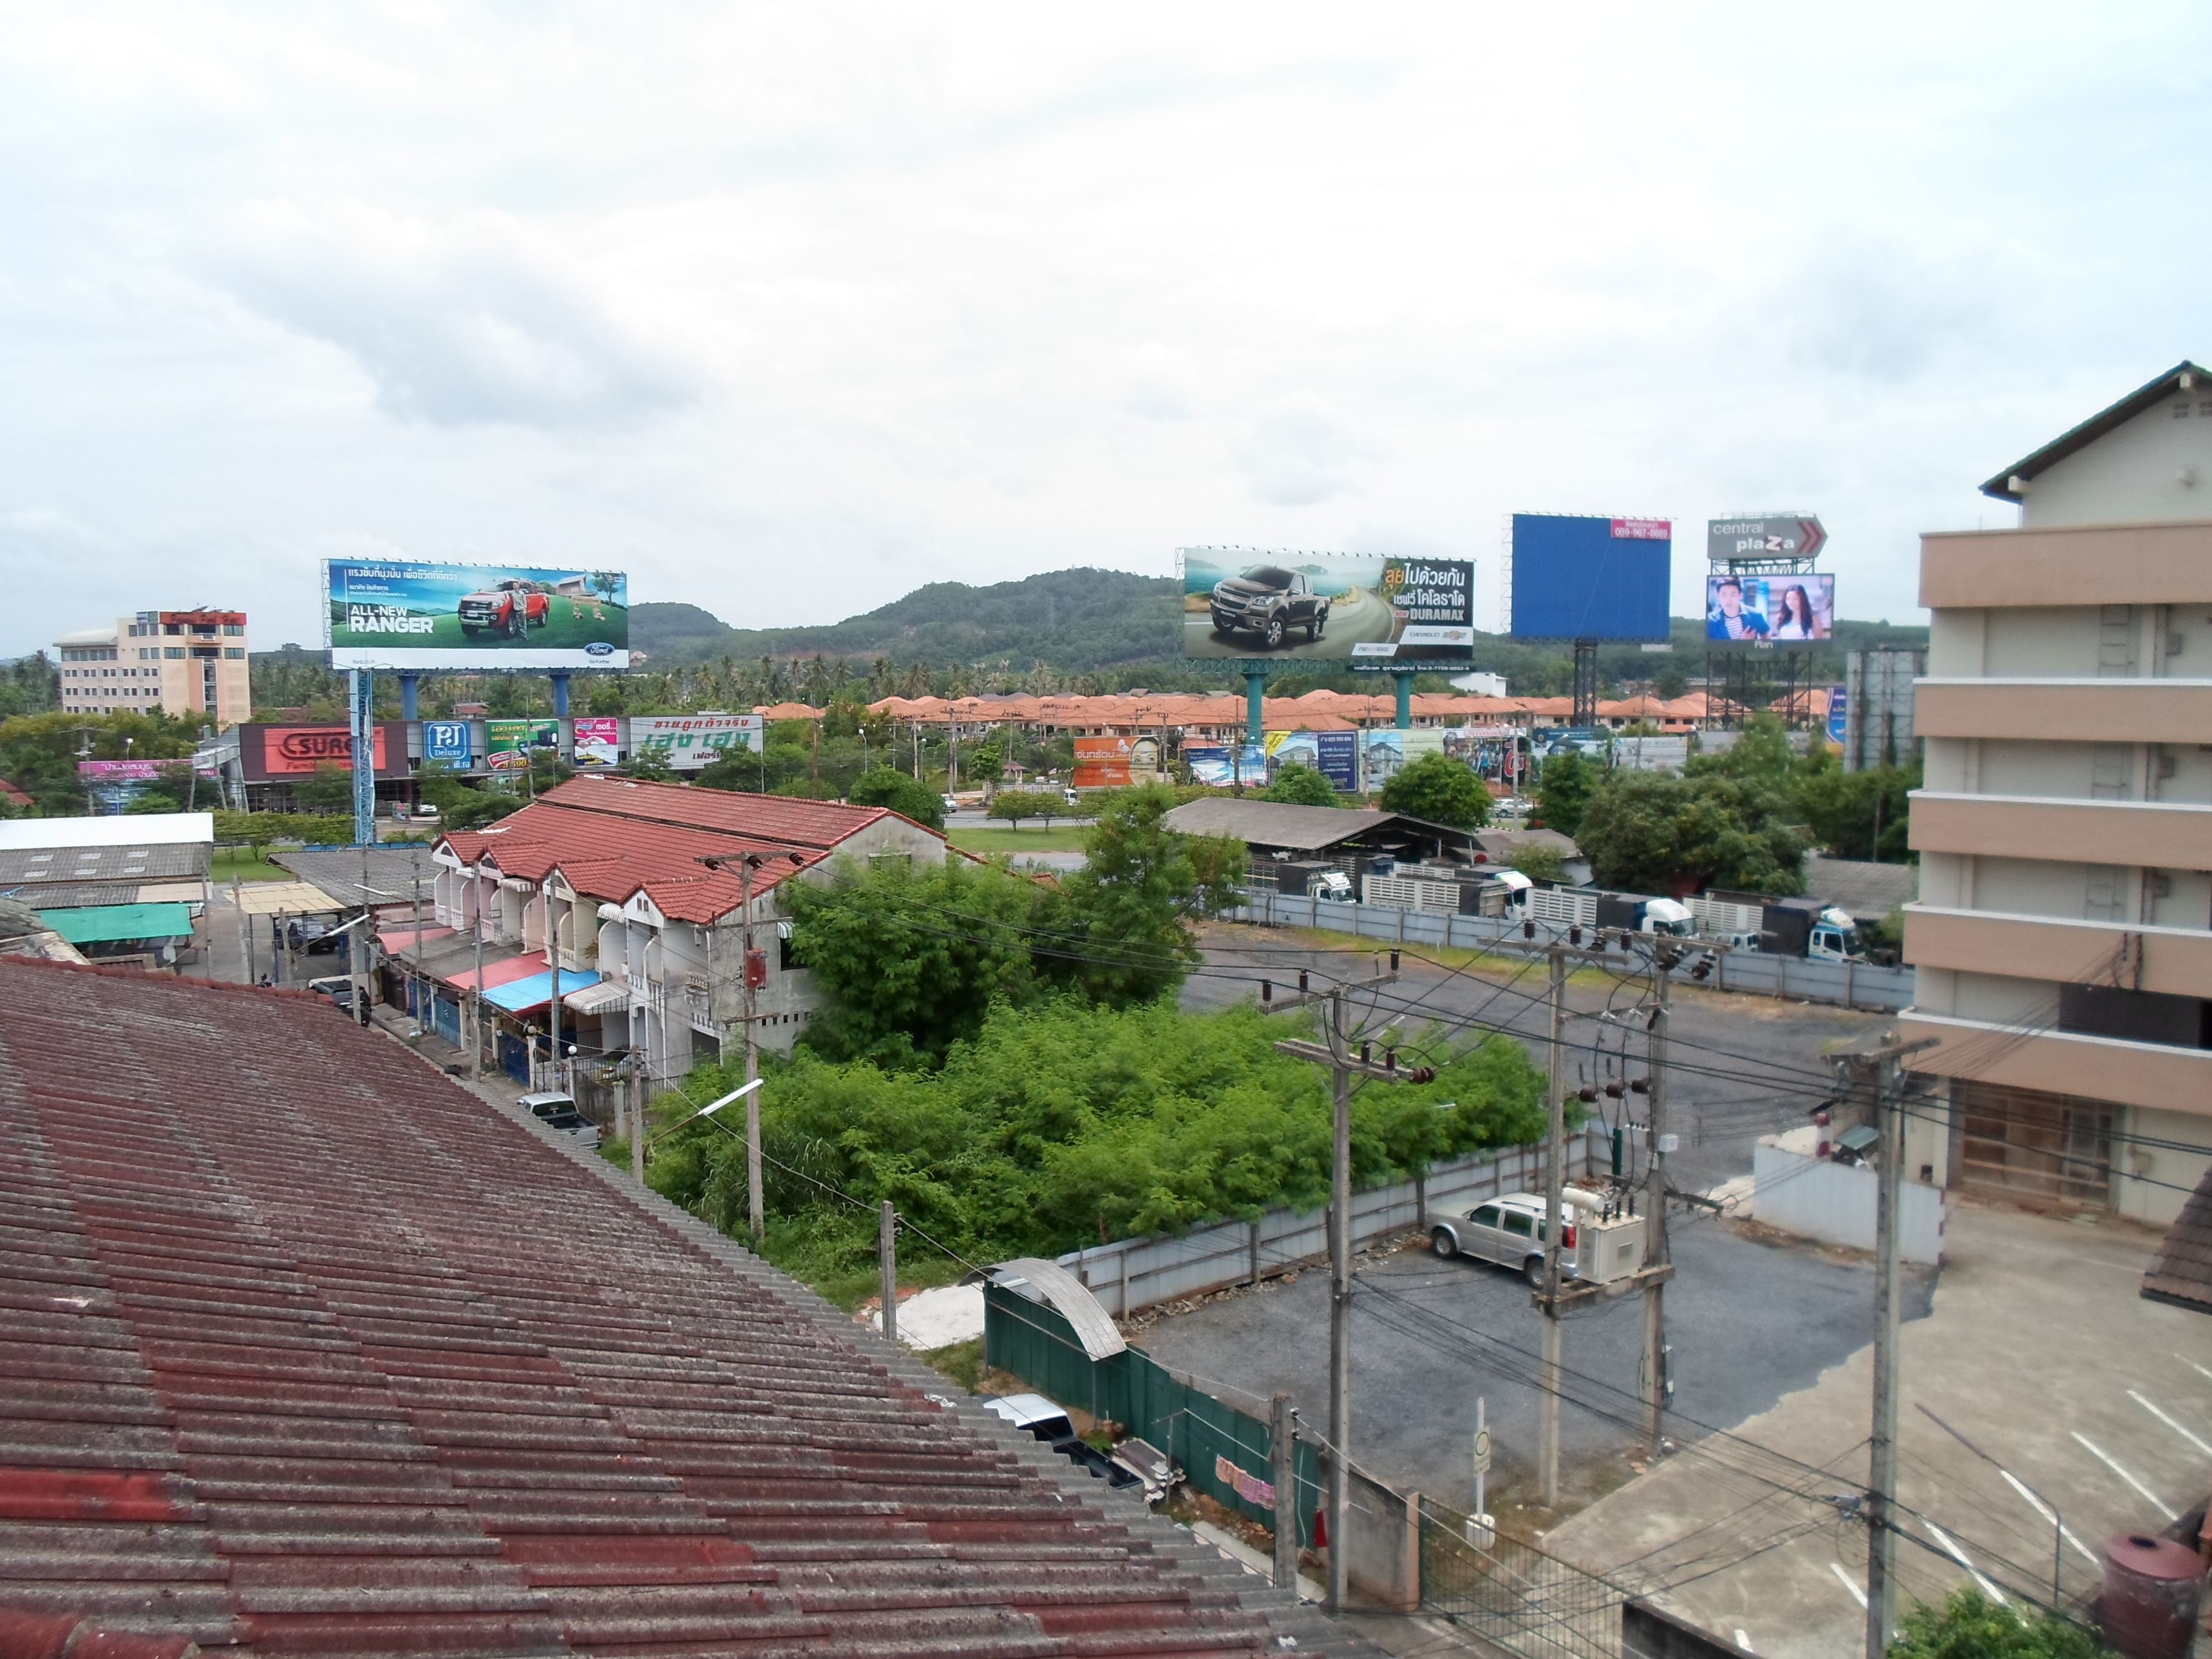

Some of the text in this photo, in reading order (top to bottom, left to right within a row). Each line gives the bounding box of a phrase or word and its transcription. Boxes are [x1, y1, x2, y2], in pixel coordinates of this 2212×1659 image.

[1713, 521, 1763, 534] central
[1417, 589, 1466, 606] โคโลราโด
[350, 605, 407, 616] ALL-NEW
[1410, 608, 1464, 621] DURAMAX
[350, 617, 434, 634] RANGER
[590, 644, 609, 654] Ford
[434, 726, 461, 748] PJ
